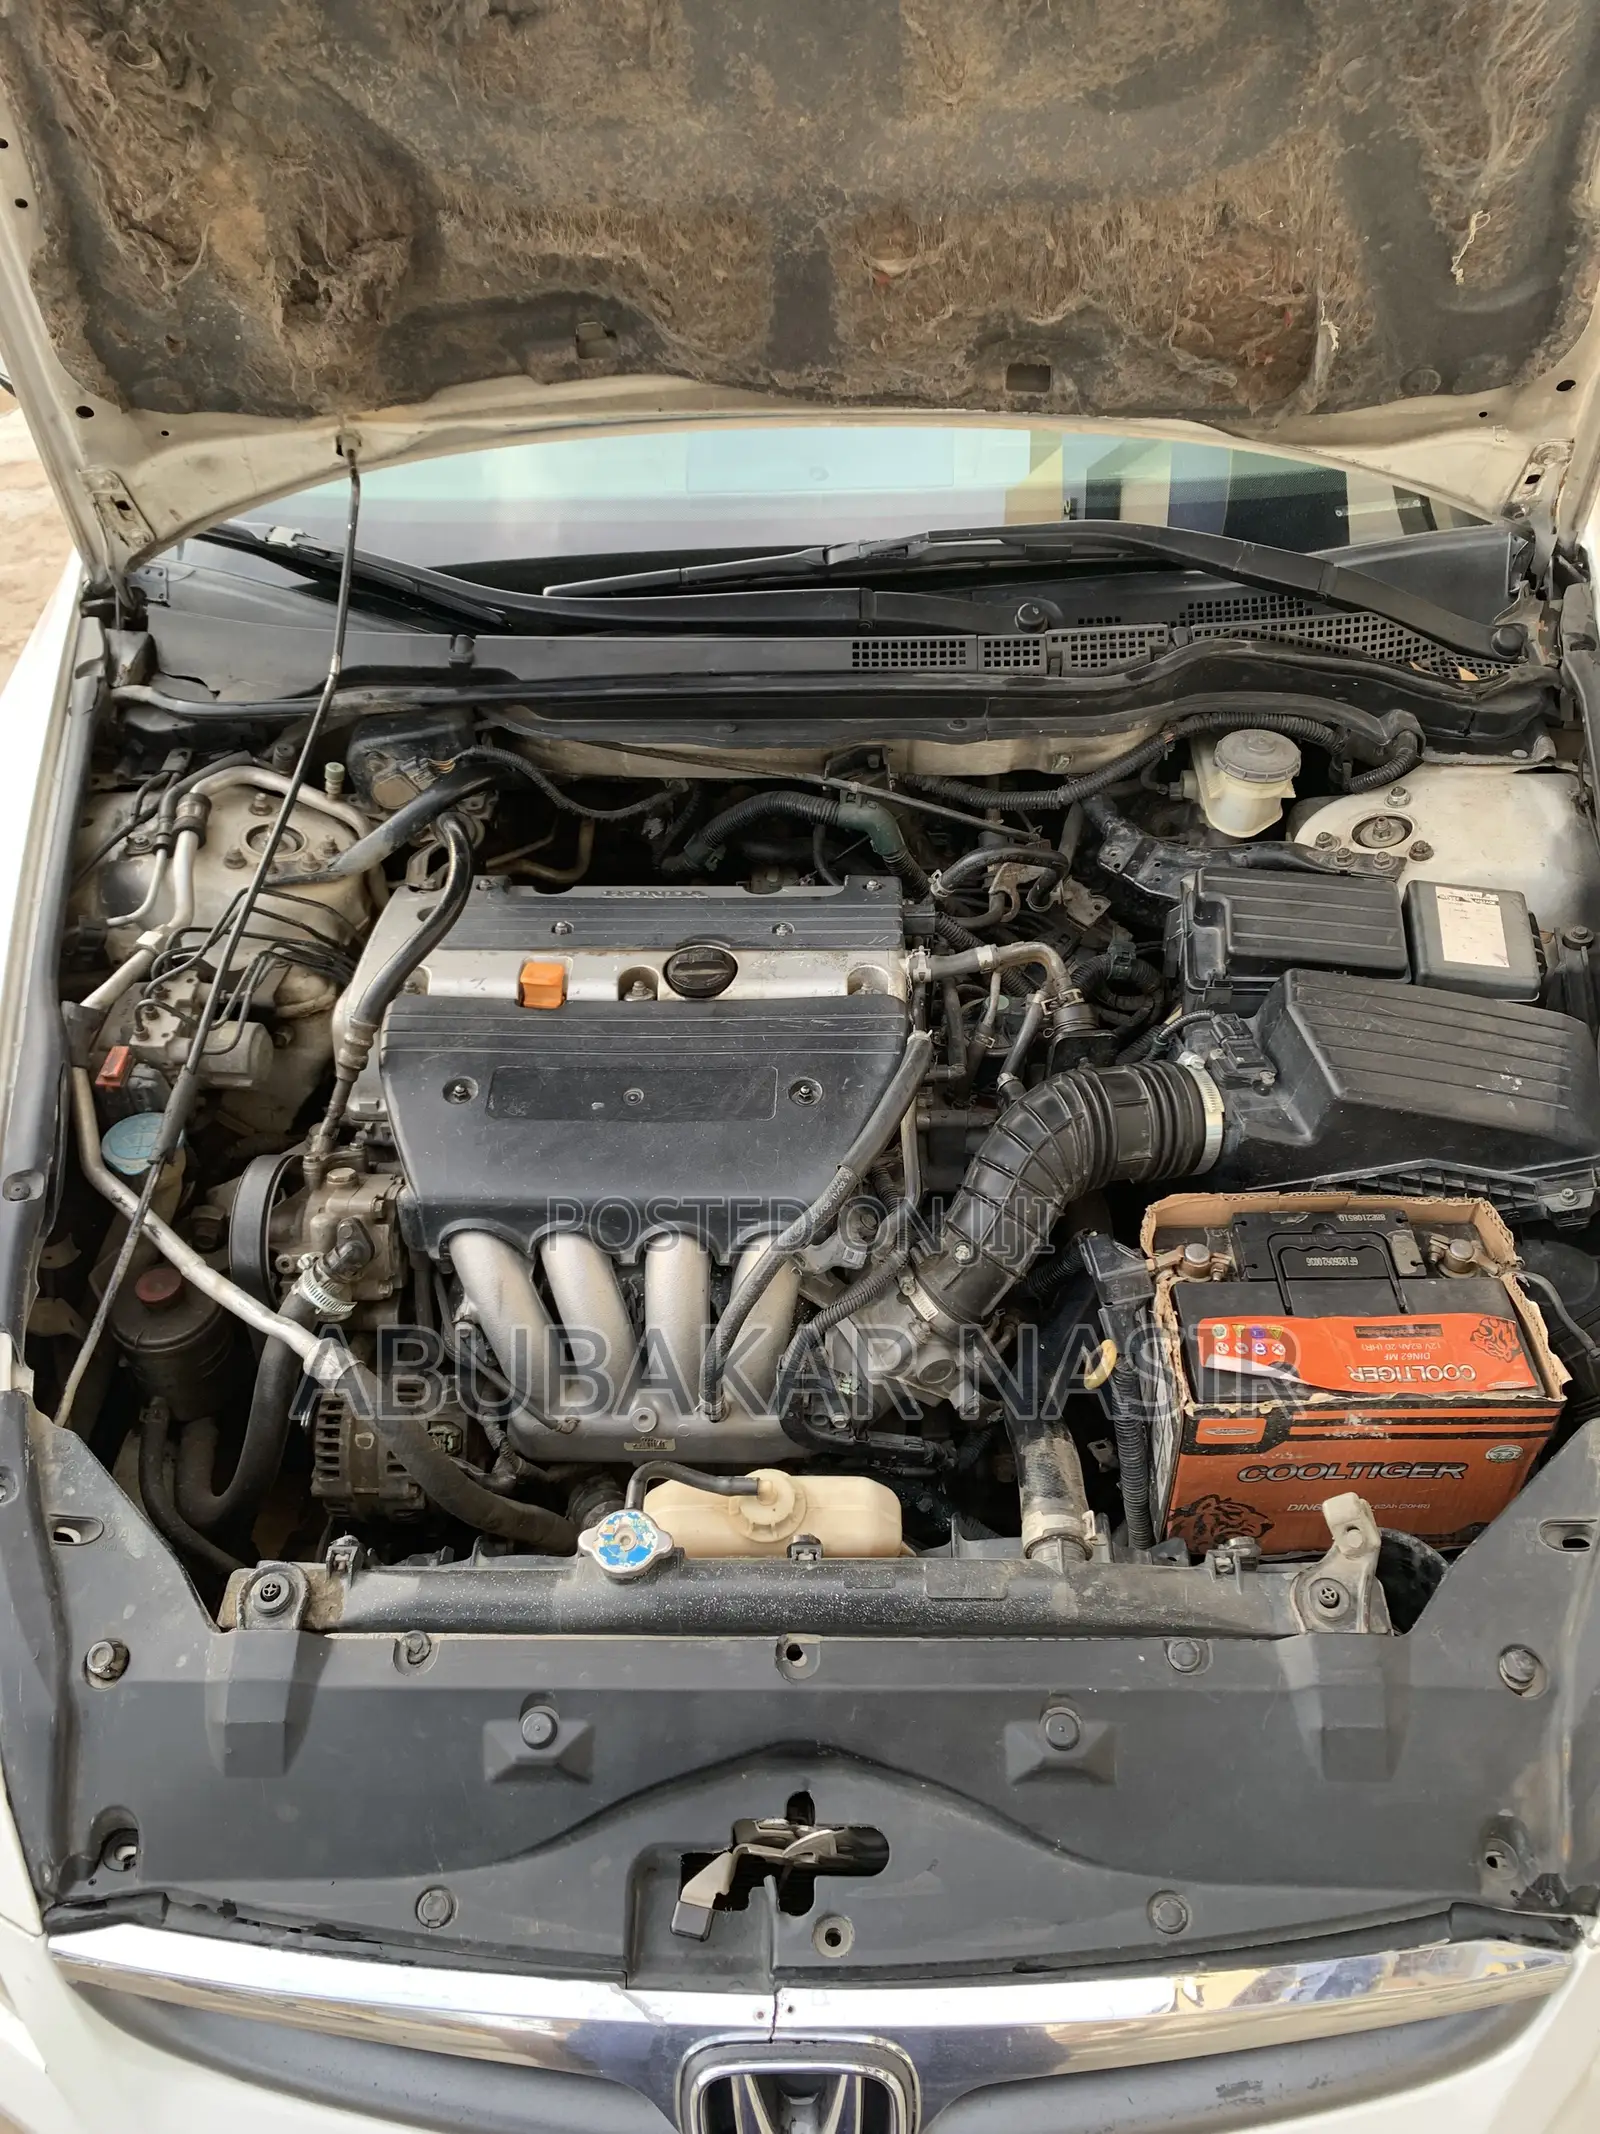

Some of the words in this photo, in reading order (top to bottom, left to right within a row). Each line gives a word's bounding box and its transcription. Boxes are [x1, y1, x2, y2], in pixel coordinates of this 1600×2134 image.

[1383, 1352, 1399, 1361] MF
[1400, 1352, 1431, 1361] DIN62
[1347, 1364, 1476, 1383] COOLTIGER
[1237, 1461, 1468, 1483] COOLTIGER
[1286, 1503, 1324, 1512] DIN6
